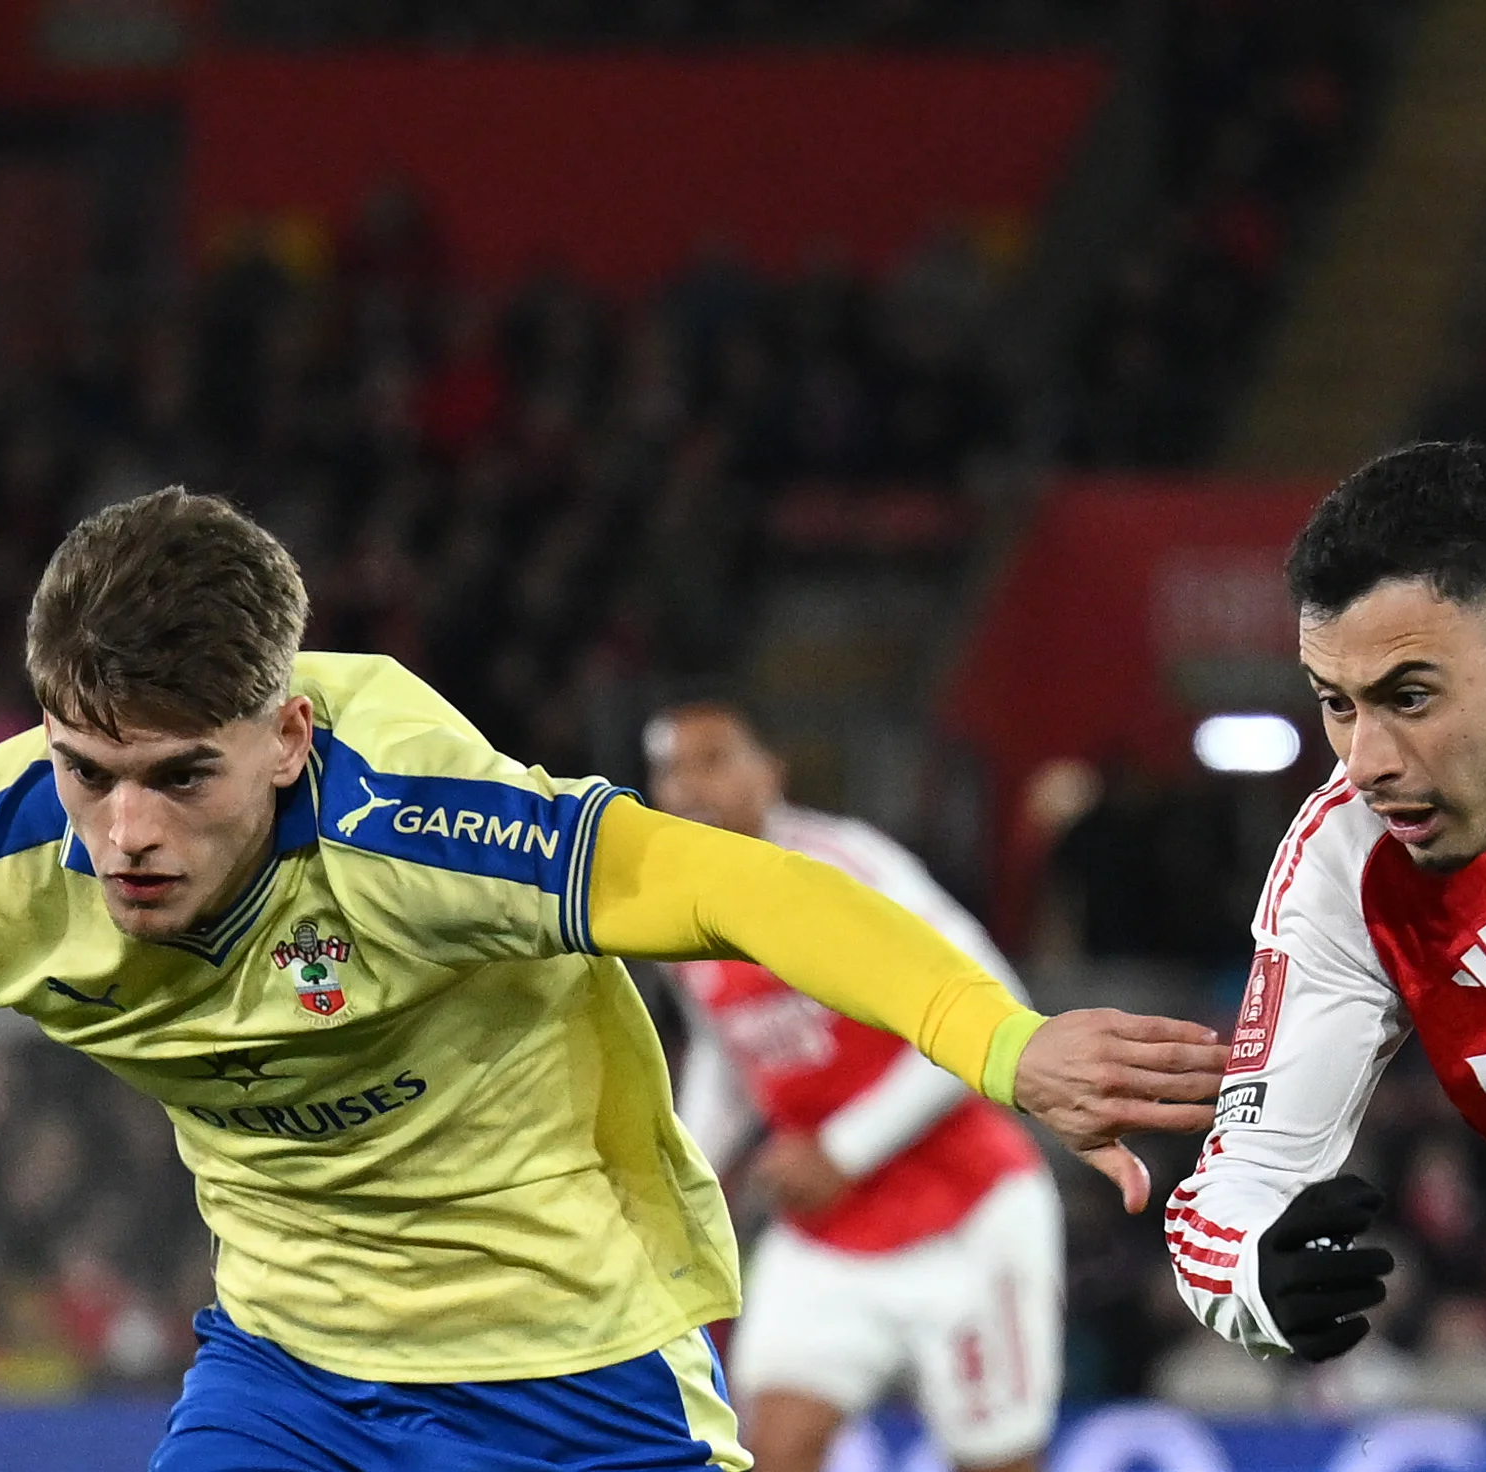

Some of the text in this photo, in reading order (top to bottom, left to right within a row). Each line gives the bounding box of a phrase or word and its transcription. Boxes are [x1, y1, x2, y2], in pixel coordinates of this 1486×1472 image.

[393, 805, 559, 860] GARMN
[1241, 1042, 1264, 1058] CUP
[229, 1069, 427, 1135] CRUISES
